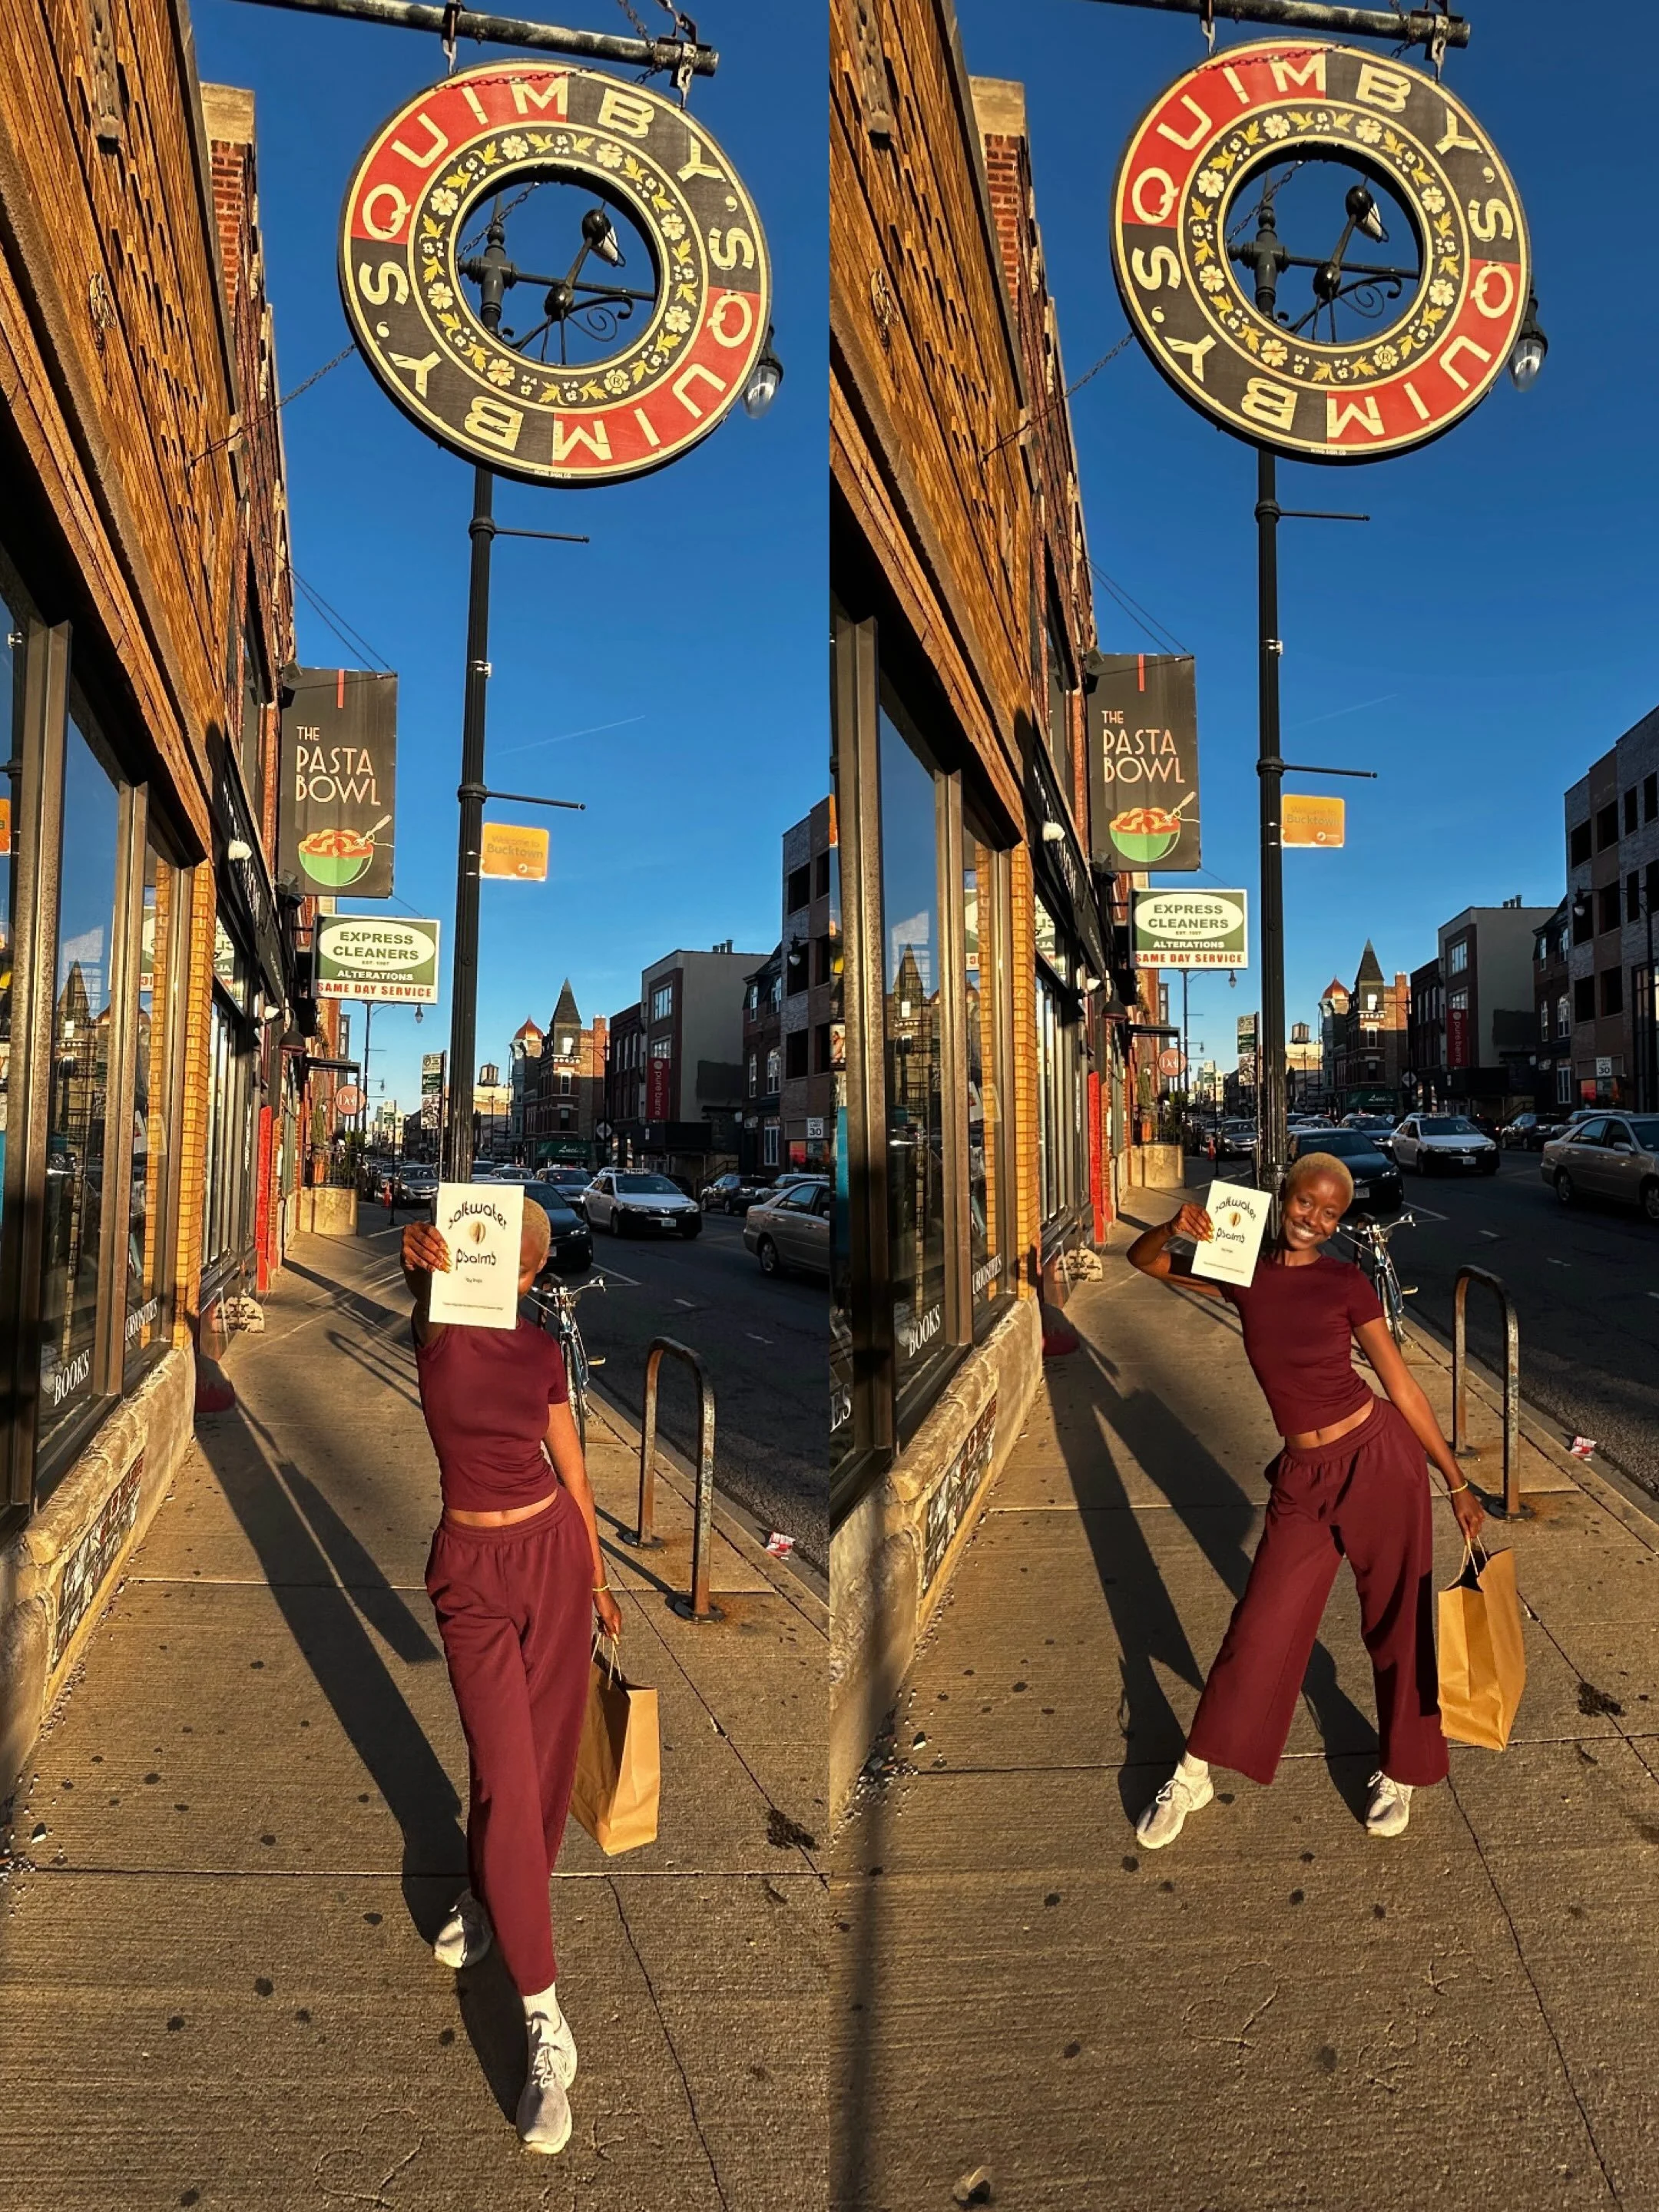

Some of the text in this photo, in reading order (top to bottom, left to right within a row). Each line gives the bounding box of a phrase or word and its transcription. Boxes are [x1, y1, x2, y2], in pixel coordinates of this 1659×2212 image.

[1131, 52, 1514, 242] QUIMBY'S
[361, 75, 753, 270] QUIMBY'S
[1132, 246, 1515, 438] QUIMBY'S
[359, 261, 753, 462] QUIMBY'S
[1101, 710, 1124, 724] THE
[296, 725, 320, 741] THE
[1103, 729, 1177, 756] PASTA
[296, 746, 374, 776] PASTA
[1104, 757, 1186, 783] BOWL
[296, 774, 381, 806] BOWL
[1286, 814, 1341, 826] Bucktown
[486, 843, 544, 859] Bucktown
[1154, 905, 1224, 914] EXPRESS
[1148, 918, 1229, 929] CLEANERS
[339, 931, 414, 945] EXPRESS
[1153, 940, 1225, 949] ALTERATIONS
[333, 945, 419, 960] CLEANERS
[1134, 953, 1243, 963] SAME DAY SERVICE
[336, 969, 415, 981] ALTERATIONS
[316, 982, 432, 998] SAME DAY SERVICE
[810, 1128, 822, 1136] 30
[909, 1303, 941, 1359] BOOKS
[54, 1348, 90, 1407] BOOKS
